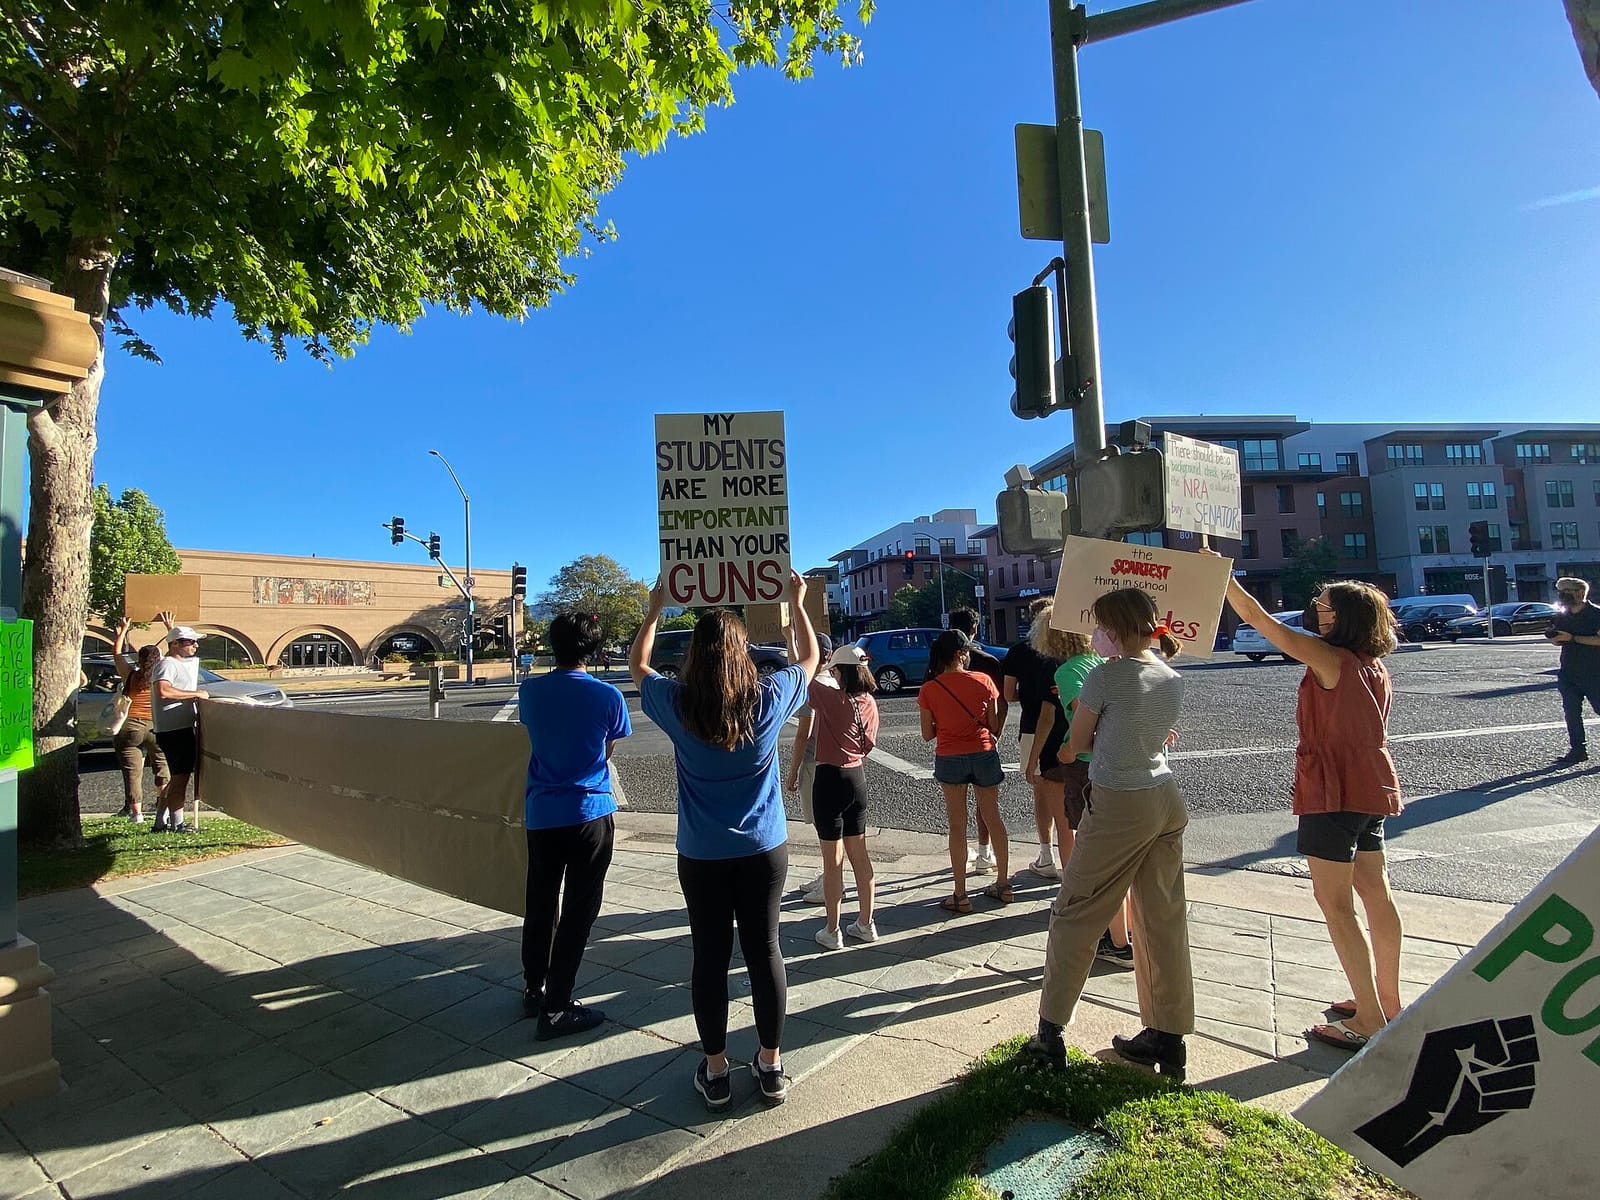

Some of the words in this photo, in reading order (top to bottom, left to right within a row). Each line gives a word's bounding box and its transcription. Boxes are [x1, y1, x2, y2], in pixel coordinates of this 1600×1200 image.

[704, 414, 735, 436] MY
[656, 439, 785, 471] STUDENTS
[1168, 441, 1192, 459] There
[1193, 447, 1214, 462] should
[1216, 451, 1225, 465] be
[661, 478, 707, 500] ARE
[722, 474, 784, 497] MORE
[1183, 478, 1209, 500] NRA
[658, 506, 788, 530] IMPORTANT
[1194, 503, 1239, 531] SENATOR
[659, 535, 724, 560] THAN
[730, 533, 790, 557] YOUR
[1132, 548, 1153, 560] the
[1111, 559, 1171, 580] SCARIEST
[669, 560, 783, 604] GUNS
[1093, 576, 1119, 588] thing
[1122, 578, 1132, 587] in
[1133, 580, 1168, 592] school
